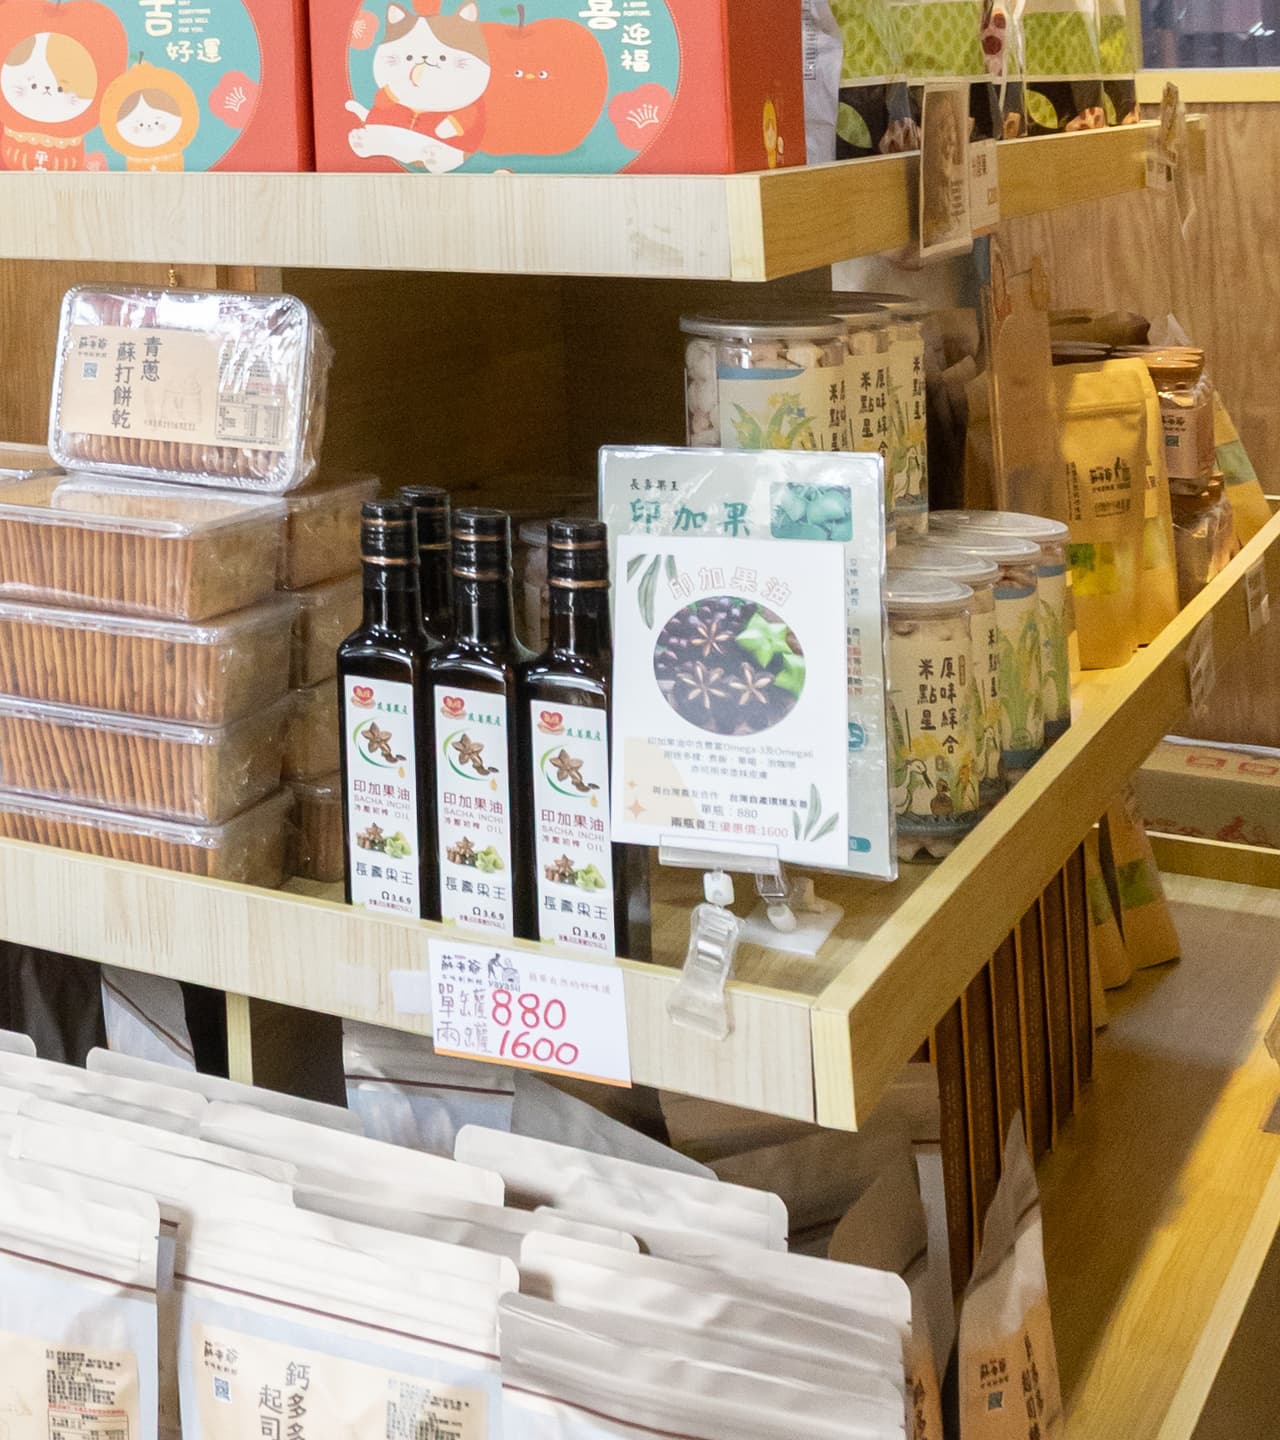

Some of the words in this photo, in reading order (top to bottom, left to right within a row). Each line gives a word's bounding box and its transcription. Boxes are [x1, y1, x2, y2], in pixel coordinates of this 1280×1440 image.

[165, 37, 222, 64] 好運
[620, 23, 652, 73] 迎福
[111, 341, 137, 430] 蘇打餅乾
[628, 496, 753, 538] 印加果
[665, 565, 794, 608] 印加果油
[917, 658, 938, 731] 米點星
[940, 656, 960, 754] 原味綜合
[353, 778, 412, 802] 印加果油
[353, 793, 384, 806] SACHA
[385, 799, 412, 812] INCHI
[394, 810, 411, 821] OIL
[443, 791, 504, 816] 印加果油
[443, 807, 475, 819] SACHA
[477, 812, 504, 825] INCHI
[486, 825, 504, 834] OIL
[541, 808, 605, 833] 印加果油
[541, 825, 576, 837] SACHA
[577, 830, 605, 843] INCHI
[586, 843, 605, 854] OIL
[355, 861, 414, 886] 長壽果王
[445, 875, 506, 901] 長壽果王
[543, 895, 608, 921] 長壽果王
[491, 988, 567, 1031] 880
[498, 1029, 580, 1066] 1600
